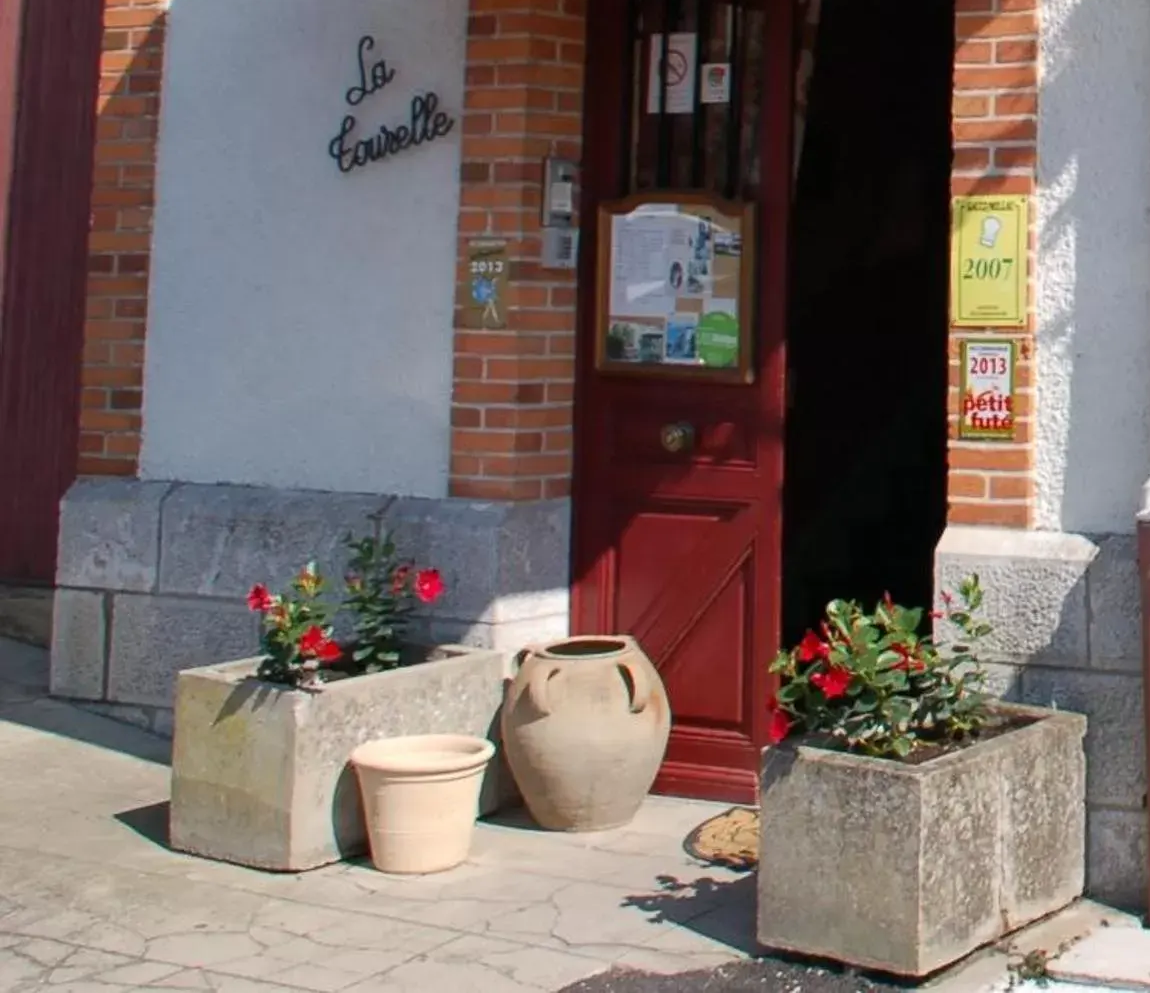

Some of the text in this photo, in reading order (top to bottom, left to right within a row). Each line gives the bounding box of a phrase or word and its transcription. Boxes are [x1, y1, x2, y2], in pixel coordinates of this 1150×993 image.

[346, 35, 396, 105] La
[471, 261, 504, 274] 2013
[962, 258, 1013, 281] 2007
[970, 357, 1007, 375] 2013
